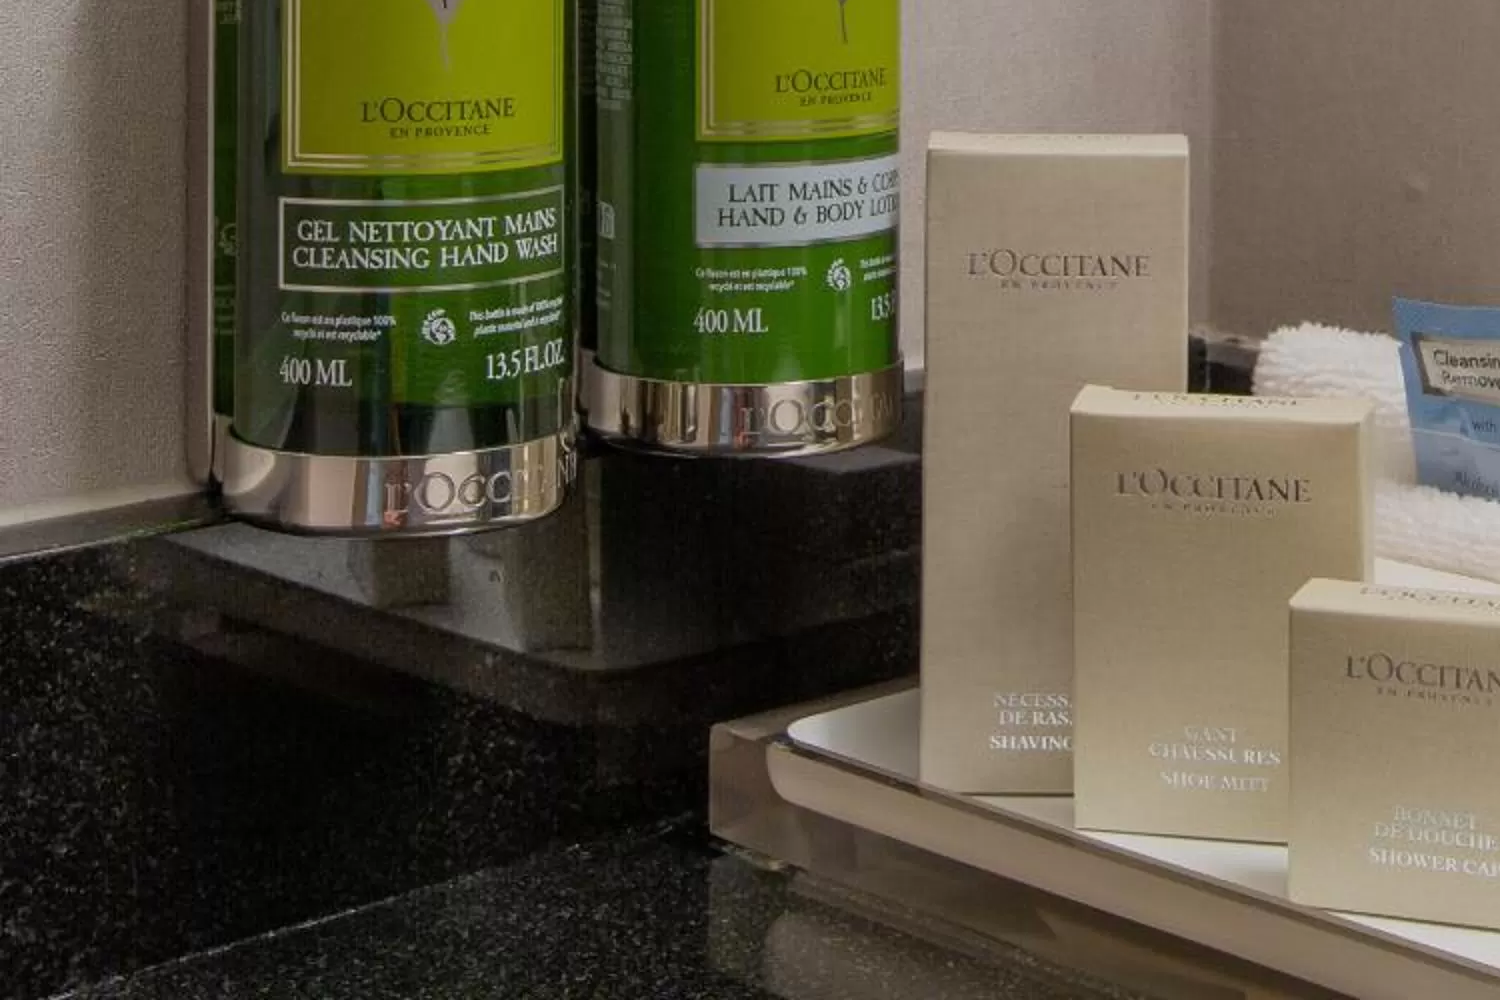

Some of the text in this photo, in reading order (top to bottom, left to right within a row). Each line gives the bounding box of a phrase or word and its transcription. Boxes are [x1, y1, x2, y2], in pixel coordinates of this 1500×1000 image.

[360, 96, 517, 123] L'OCCITANE
[414, 123, 494, 138] PROVENCE
[727, 183, 779, 203] LAIT
[788, 178, 853, 202] MAINS
[857, 176, 869, 195] &
[297, 207, 557, 243] GEL NETTOYANT MAINS
[717, 207, 785, 227] HAND
[793, 206, 808, 226] &
[816, 200, 866, 225] BODY
[292, 232, 558, 270] CLEANSING HAND WASH
[967, 248, 1151, 277] L'OCCITANE
[693, 307, 769, 333] 400 ML
[279, 355, 353, 387] 400 ML
[485, 350, 521, 380] 13.5
[1471, 418, 1496, 433] with
[1115, 468, 1312, 504] L'OCCITANE
[1033, 710, 1073, 726] RAS
[1369, 848, 1458, 873] SHOWER
